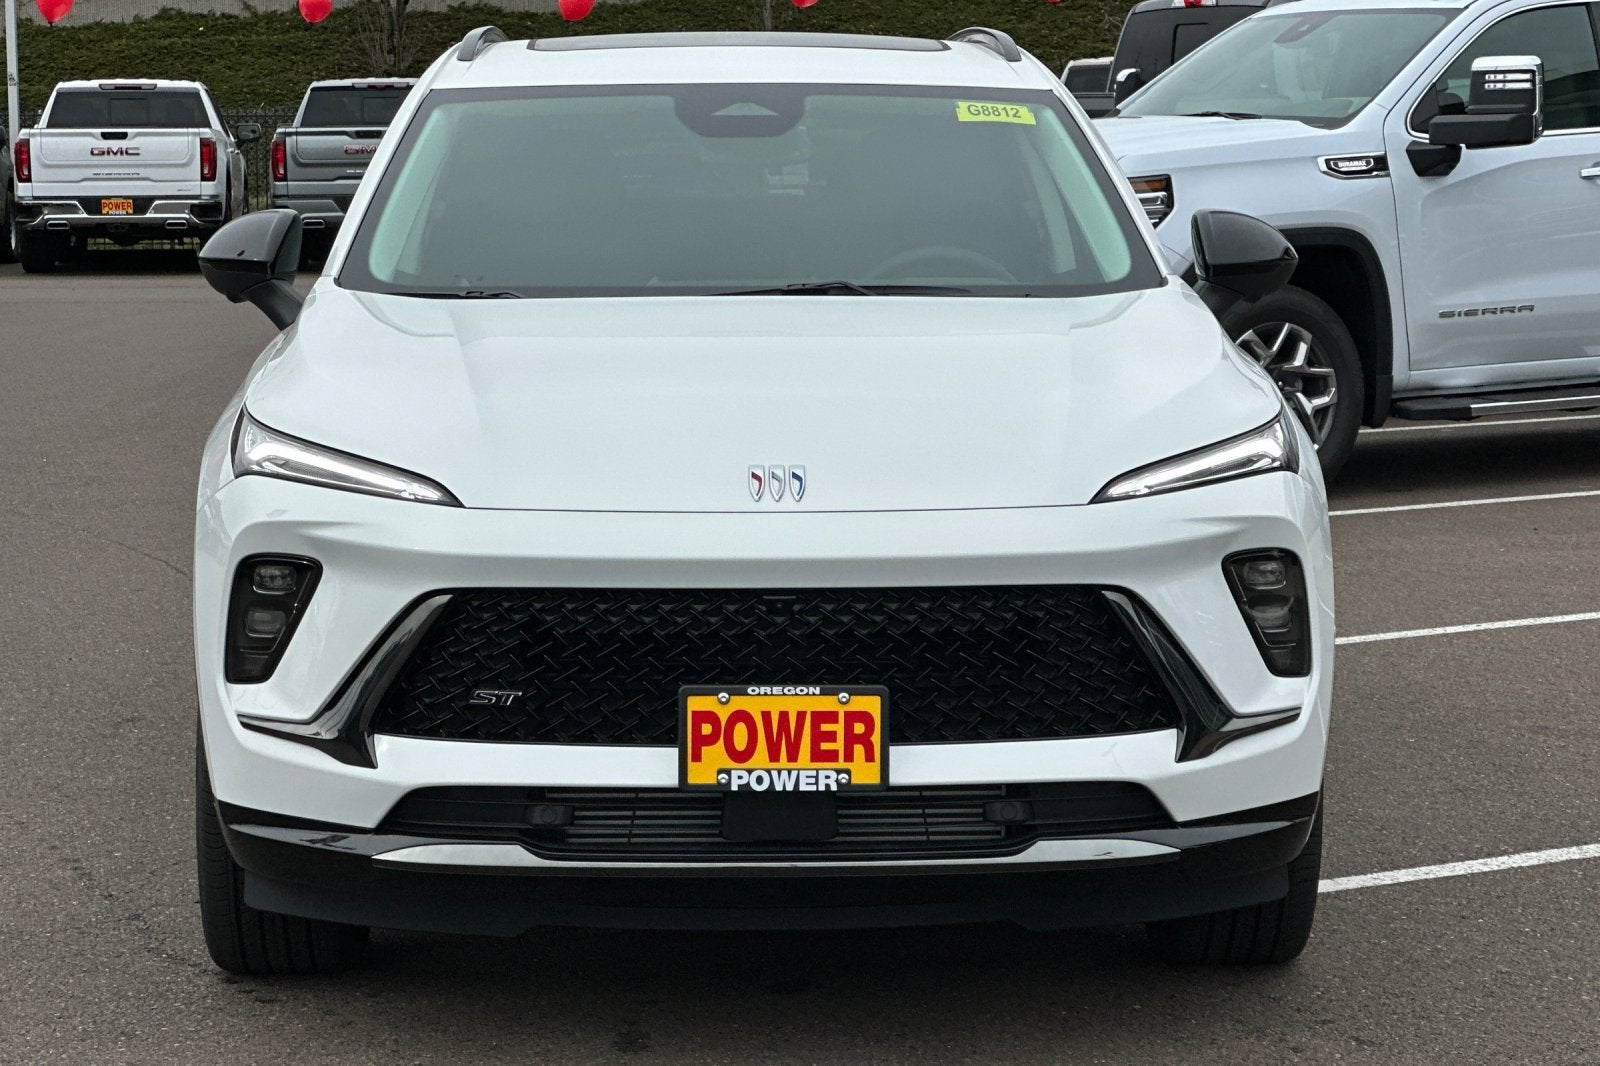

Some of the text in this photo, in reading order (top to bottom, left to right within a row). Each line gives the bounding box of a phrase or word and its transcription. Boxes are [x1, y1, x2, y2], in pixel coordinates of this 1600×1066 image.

[967, 104, 1021, 118] G8812
[90, 147, 140, 156] GMC
[344, 145, 378, 154] GM
[102, 201, 133, 210] POWER
[1438, 305, 1535, 318] SIERRA
[747, 686, 820, 695] OREGON
[469, 690, 522, 705] ST
[691, 709, 876, 764] POWER
[730, 770, 838, 791] POWER
